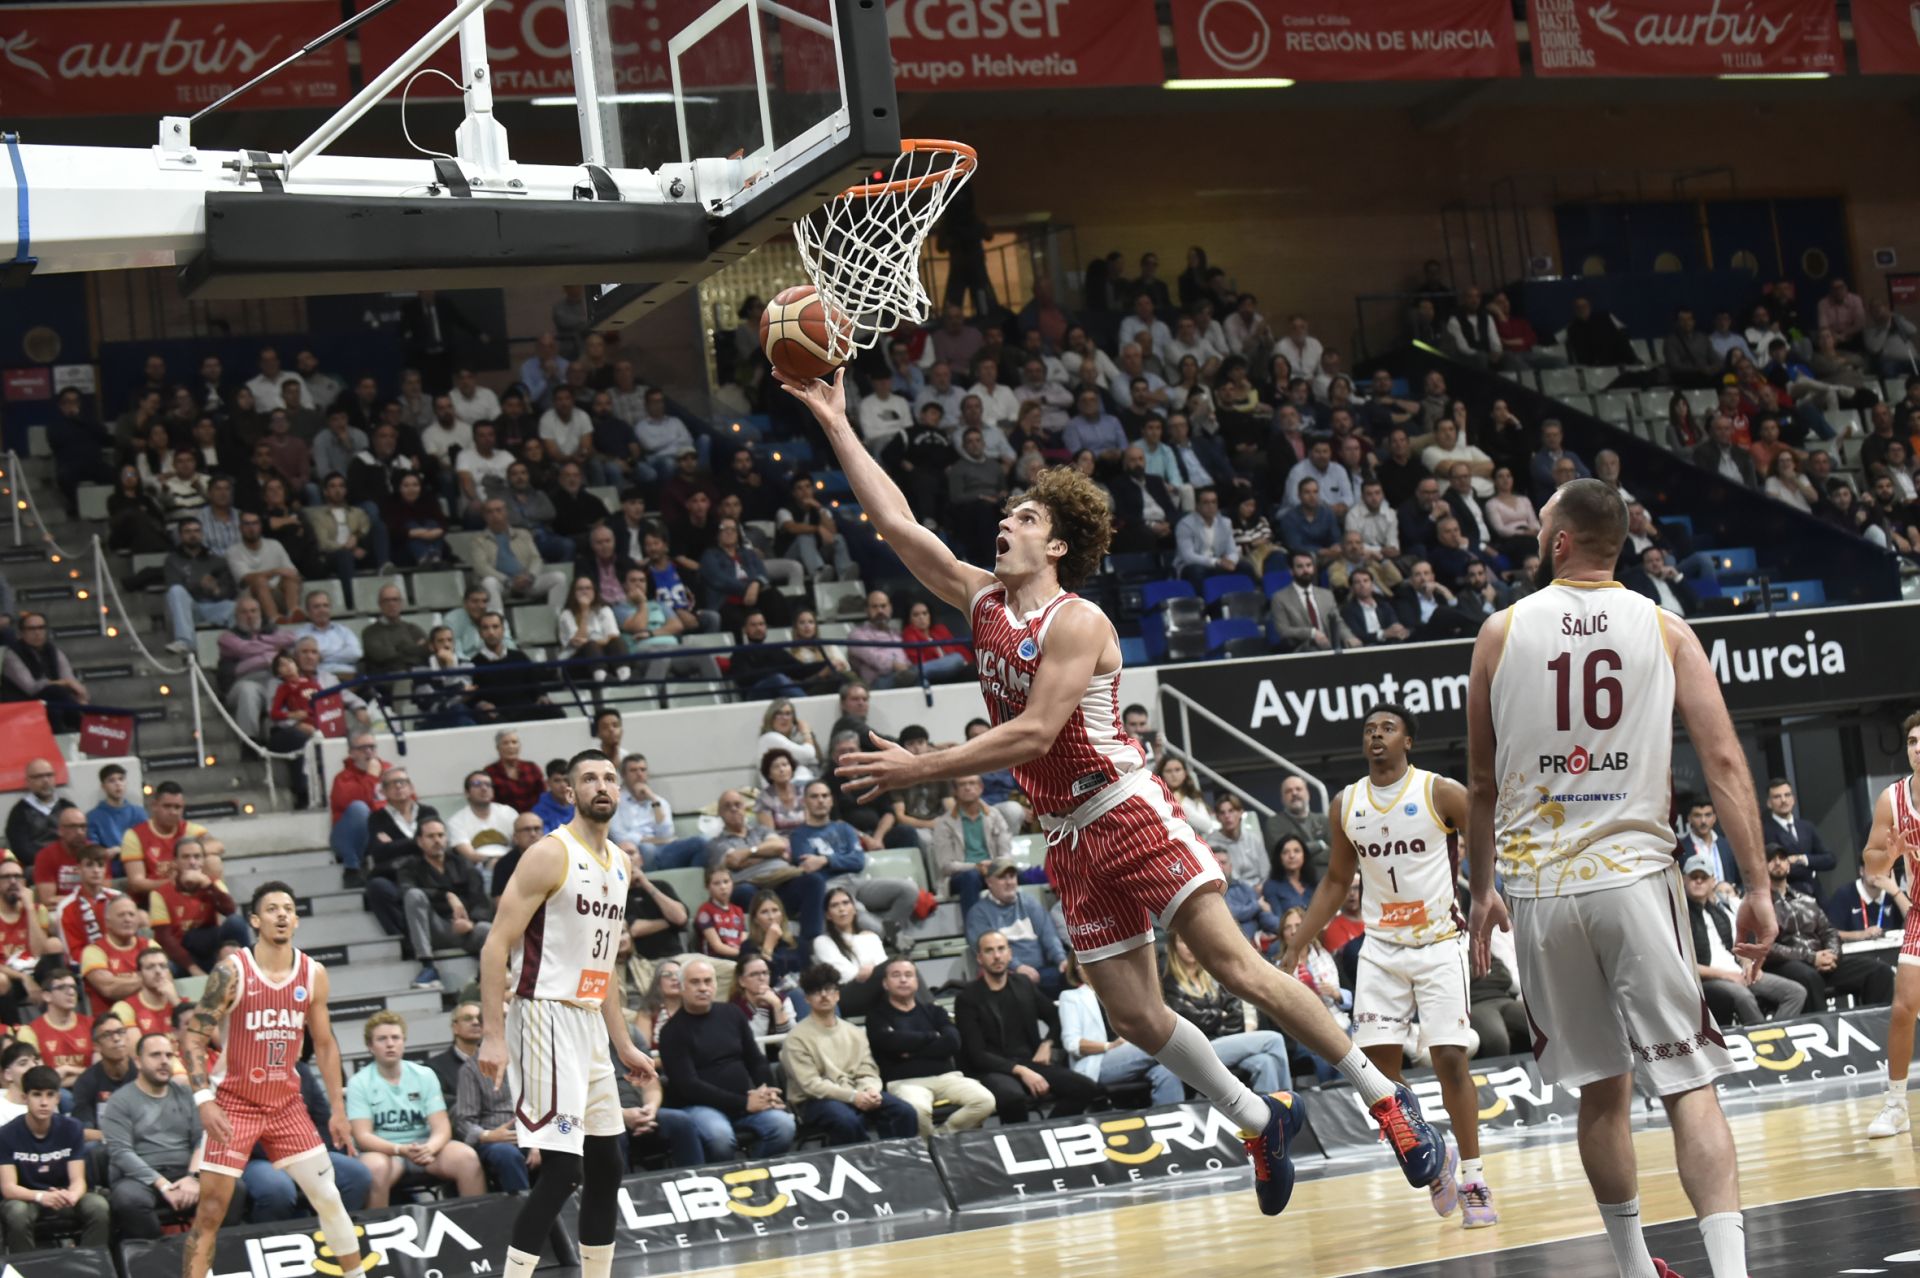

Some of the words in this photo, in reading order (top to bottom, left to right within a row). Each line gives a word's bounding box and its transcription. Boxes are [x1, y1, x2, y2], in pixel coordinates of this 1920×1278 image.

[913, 0, 1070, 40] caser
[1538, 13, 1580, 31] HASTA
[1634, 0, 1794, 46] aurbús
[58, 18, 283, 79] aurbús
[1285, 29, 1372, 51] REGIÓN
[1376, 30, 1405, 50] DE
[1411, 28, 1496, 50] MURCIA
[1540, 31, 1583, 49] DONDE
[893, 57, 965, 85] Grupo
[972, 52, 1078, 78] Helvetia
[1542, 49, 1596, 69] QUIERAS
[1561, 611, 1609, 637] ŠALIĆ
[1709, 629, 1847, 685] Murcia
[1547, 648, 1624, 732] 16
[1539, 744, 1629, 775] PROLAB
[1387, 866, 1399, 894] 1
[592, 928, 611, 961] 31
[246, 1008, 305, 1031] UCAM
[255, 1029, 297, 1042] MURCIA
[266, 1041, 288, 1068] 12
[1720, 1017, 1881, 1072] BERA
[373, 1108, 426, 1128] UCAM
[993, 1105, 1246, 1175] LIBERA
[617, 1153, 883, 1231] LIBERA
[1013, 1157, 1224, 1199] TELECO
[206, 1209, 484, 1278] IBERA
[635, 1201, 895, 1254] TELECOM
